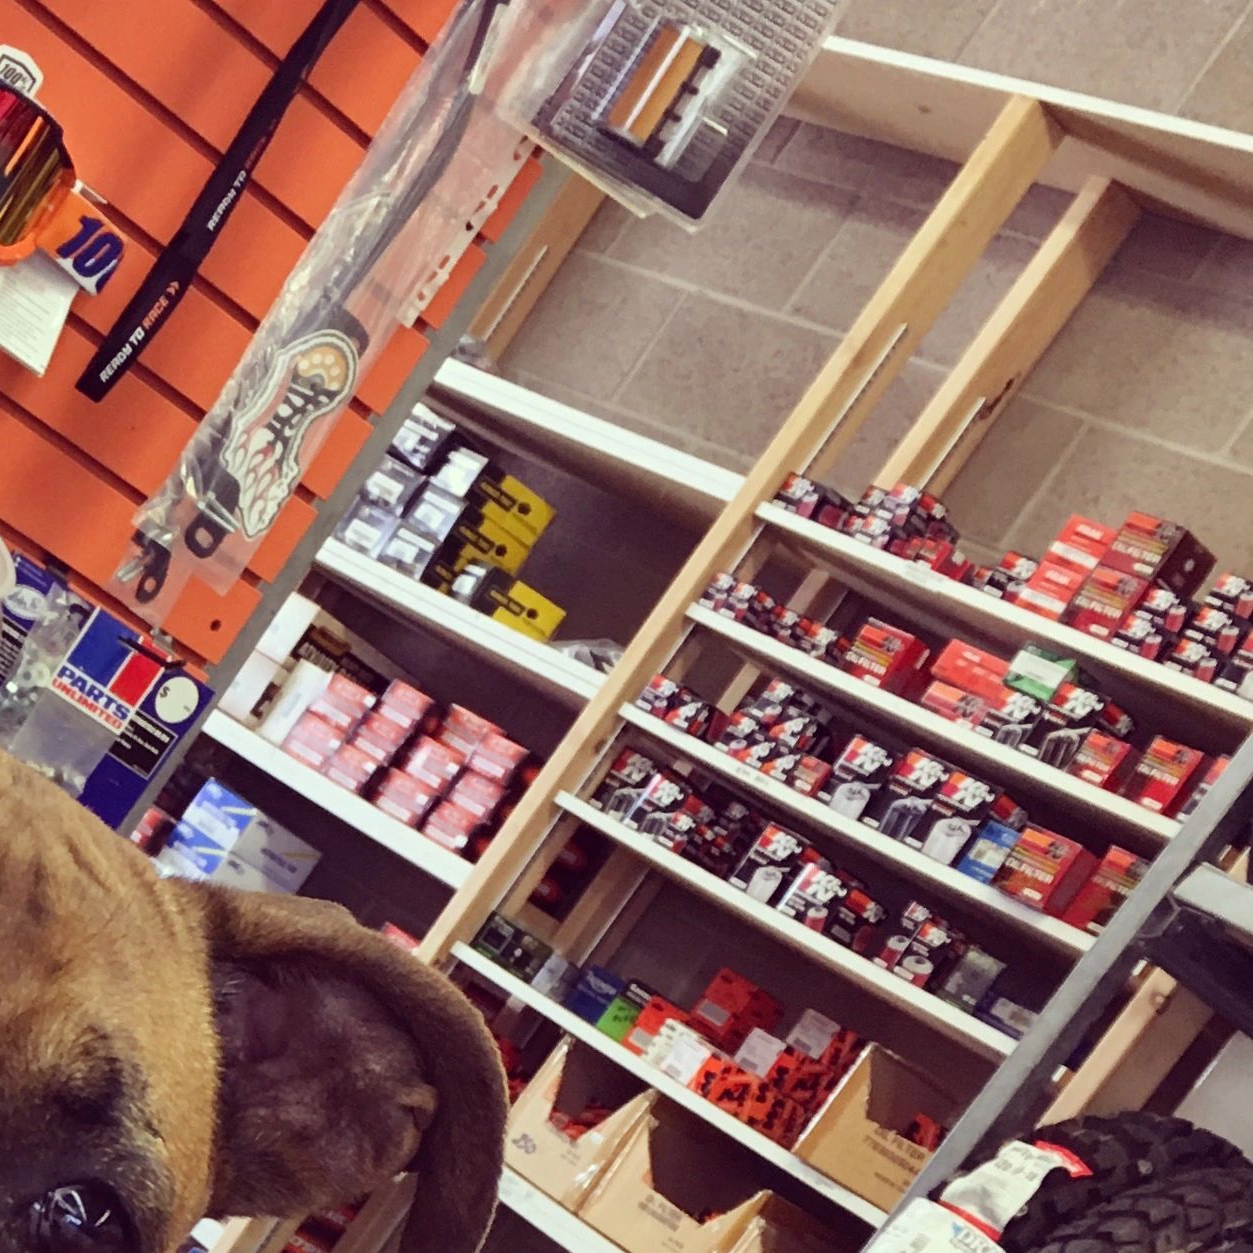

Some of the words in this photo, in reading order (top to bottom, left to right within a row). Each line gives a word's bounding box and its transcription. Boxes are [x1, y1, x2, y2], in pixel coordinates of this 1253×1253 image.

[98, 341, 133, 384] READY
[128, 326, 146, 347] TO
[50, 677, 124, 731] UNLIMITED
[56, 665, 131, 722] PARTS
